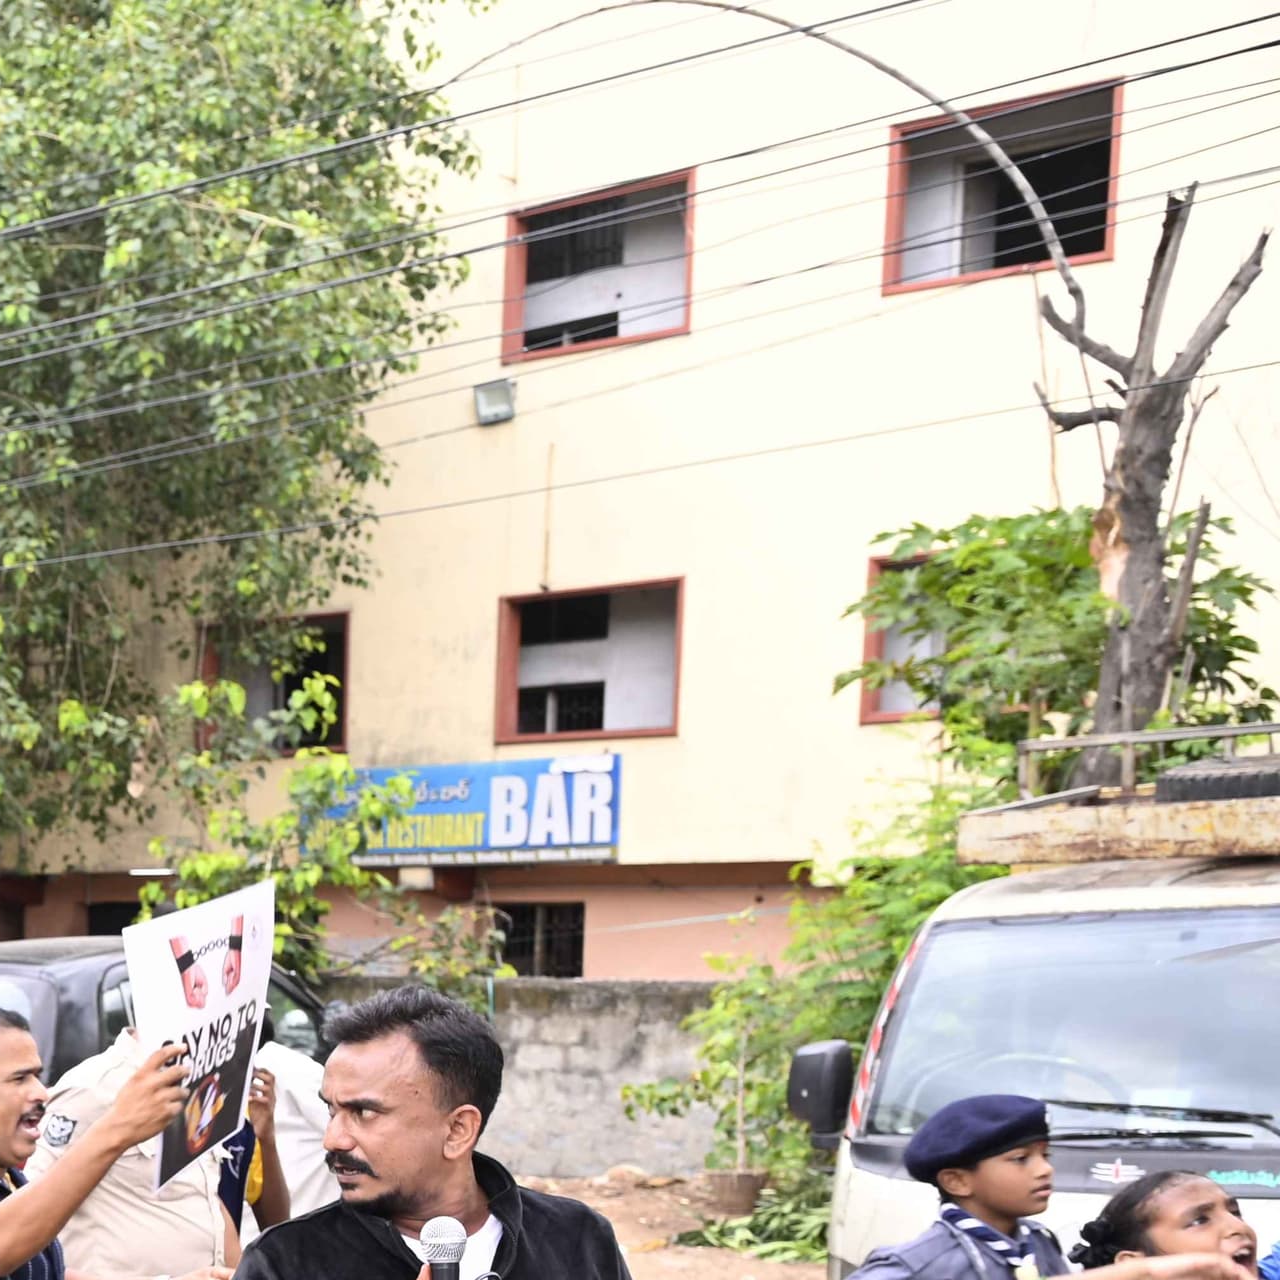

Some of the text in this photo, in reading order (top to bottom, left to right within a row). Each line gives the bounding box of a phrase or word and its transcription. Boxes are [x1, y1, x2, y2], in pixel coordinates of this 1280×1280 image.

[488, 771, 614, 848] BAR
[208, 1012, 232, 1048] NO
[237, 998, 257, 1038] TO
[181, 1037, 236, 1088] DRUGS
